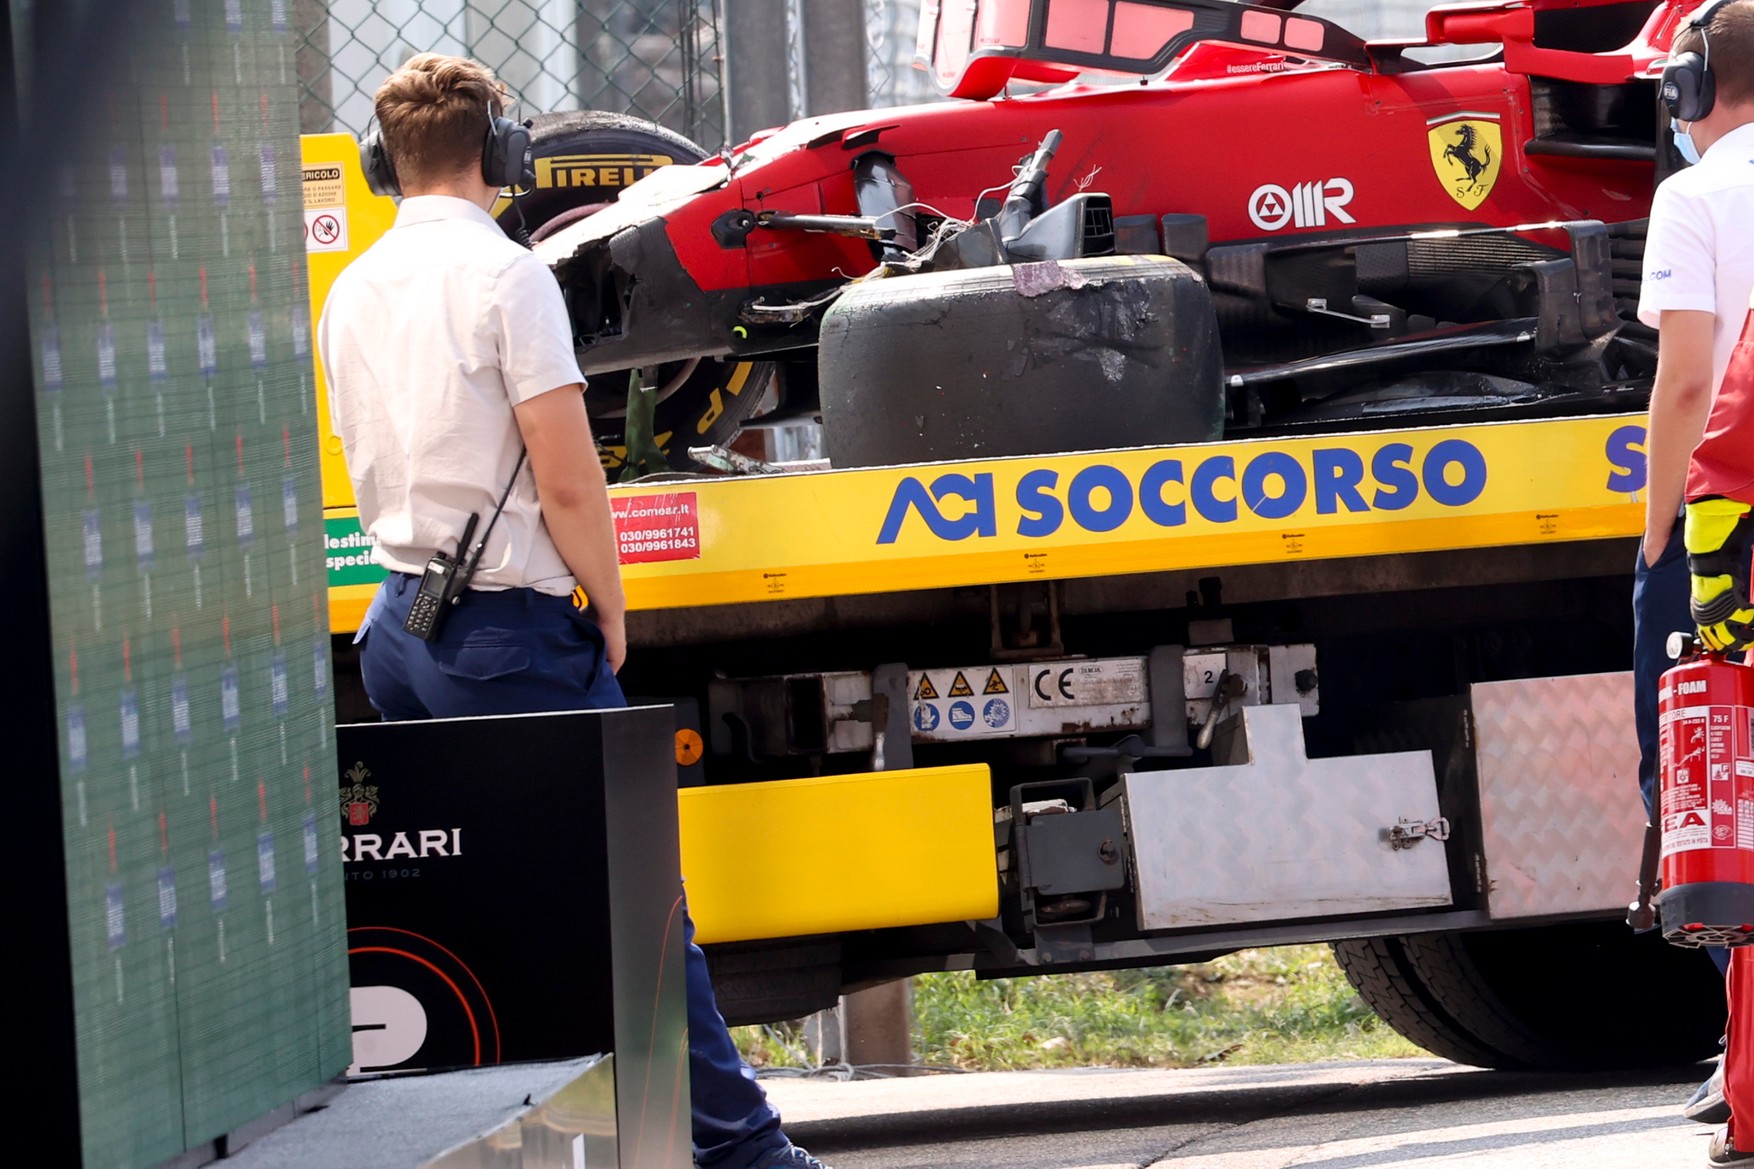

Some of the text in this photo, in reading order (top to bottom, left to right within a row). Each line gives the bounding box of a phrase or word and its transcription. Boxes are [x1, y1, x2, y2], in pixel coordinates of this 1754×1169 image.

[1015, 438, 1487, 538] SOCCORSO
[620, 526, 694, 542] 030/9961741
[620, 538, 696, 553] 030/9961843
[1034, 668, 1075, 700] CE
[1204, 670, 1213, 684] 2
[1678, 680, 1707, 696] FOAM
[1712, 715, 1723, 723] 75
[1723, 715, 1729, 723] F
[382, 868, 421, 879] 1902
